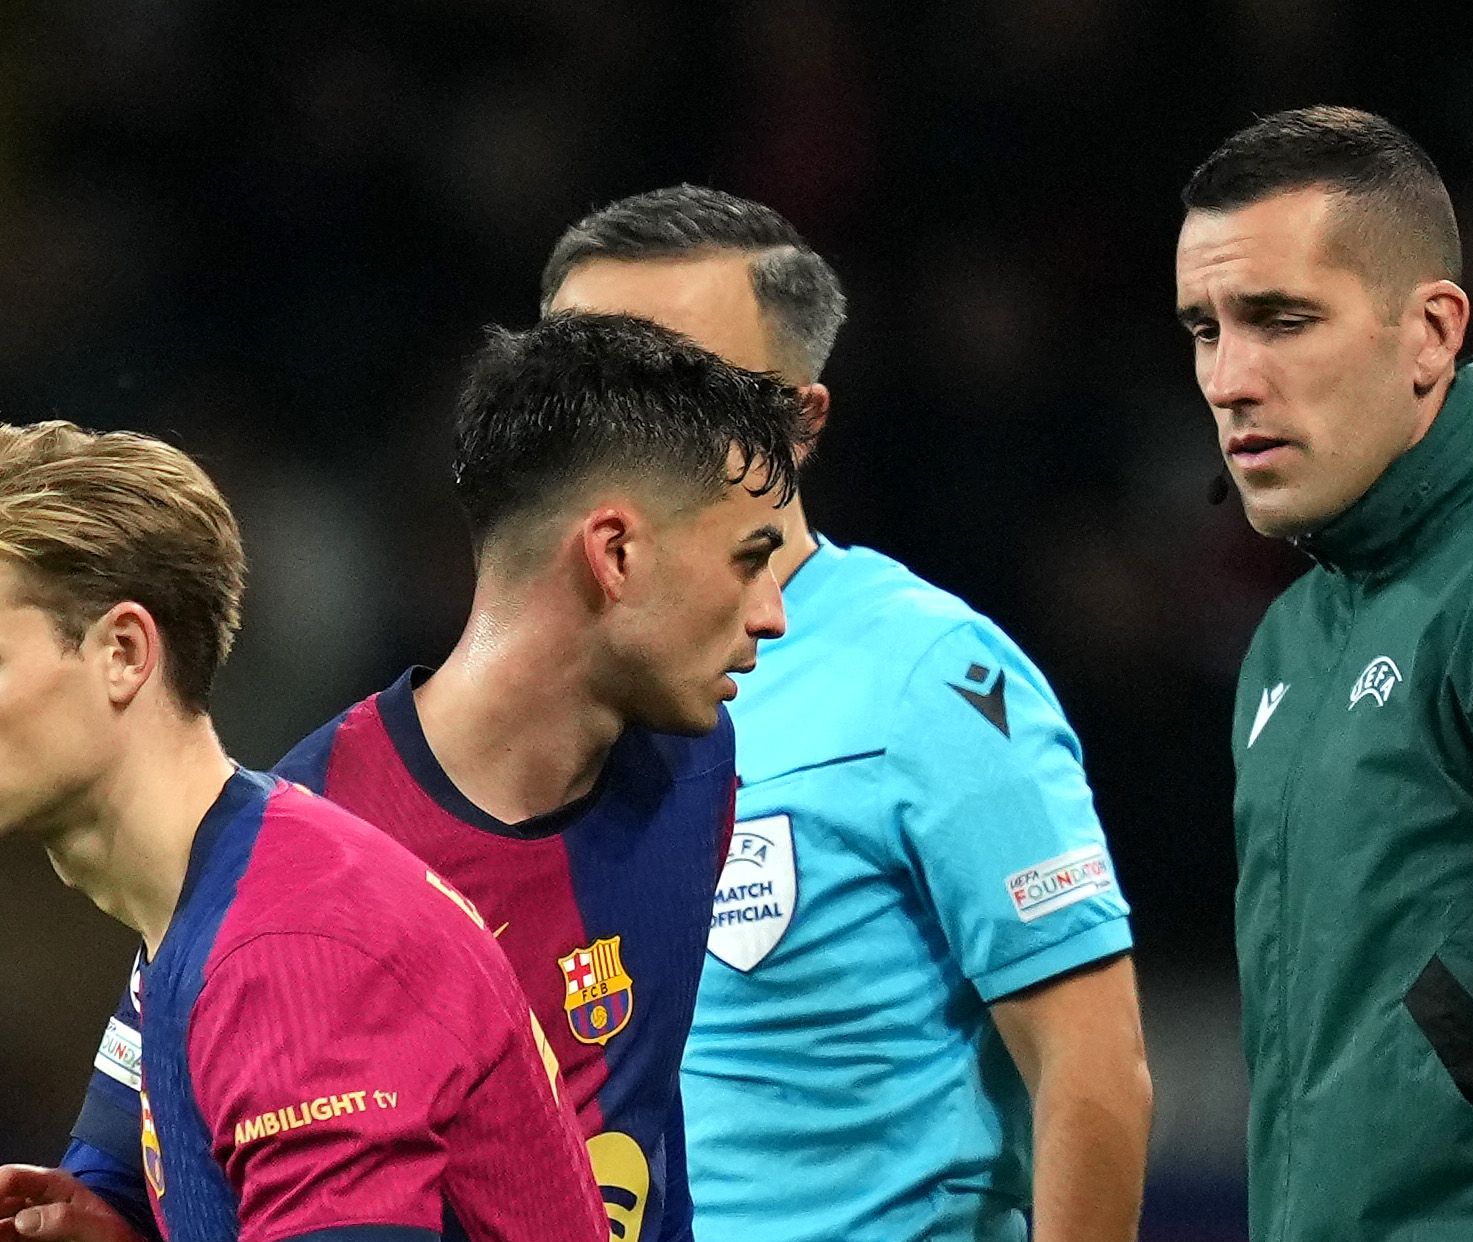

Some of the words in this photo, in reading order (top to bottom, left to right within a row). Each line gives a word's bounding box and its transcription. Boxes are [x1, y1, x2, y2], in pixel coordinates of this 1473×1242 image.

[1350, 665, 1395, 702] UEFA
[1010, 871, 1039, 888] UEFA
[581, 983, 608, 1001] FCB
[235, 1091, 367, 1145] AMBILIGHT
[373, 1090, 398, 1109] tv
